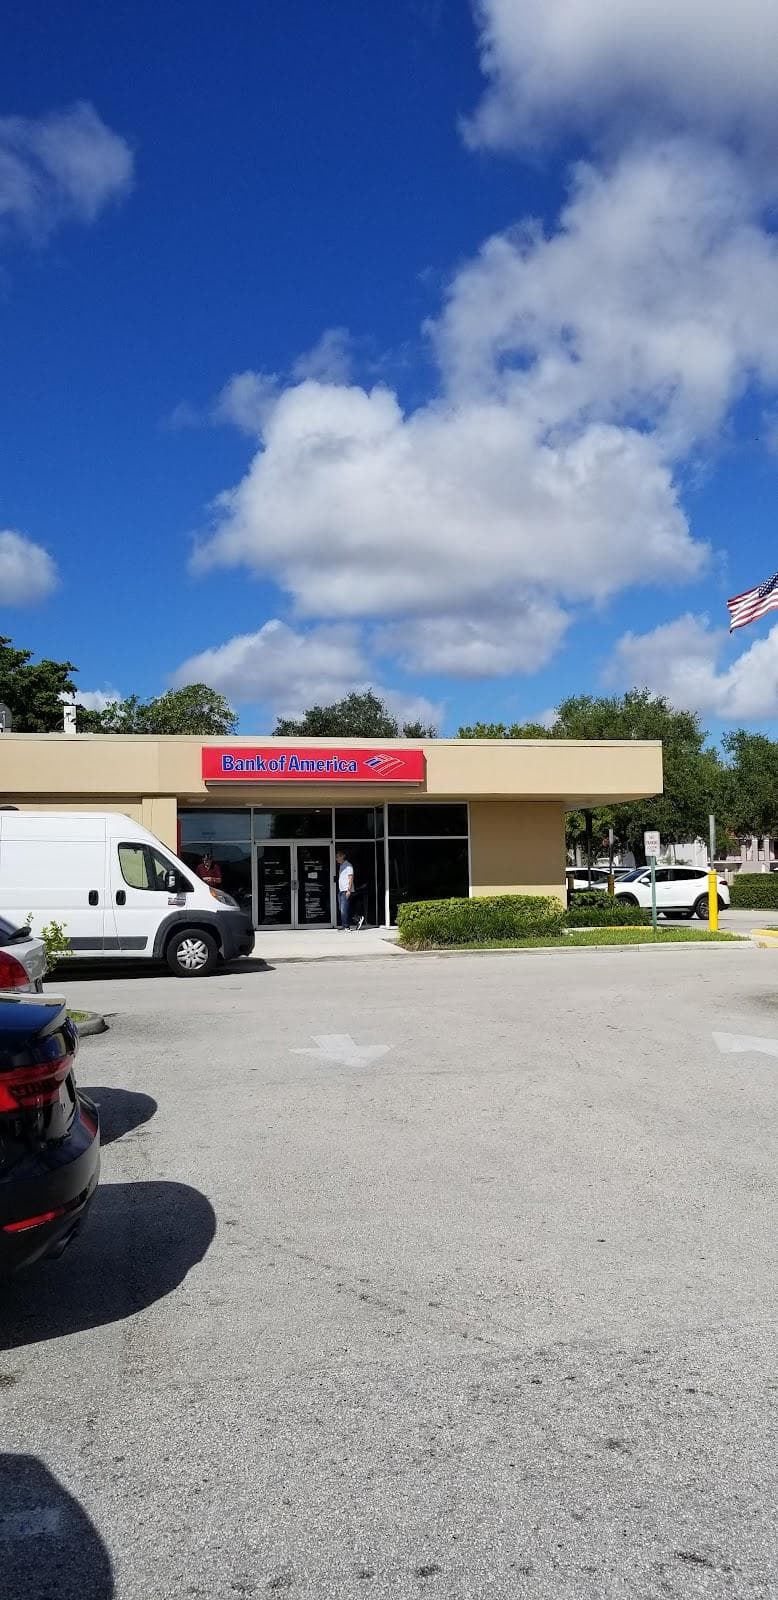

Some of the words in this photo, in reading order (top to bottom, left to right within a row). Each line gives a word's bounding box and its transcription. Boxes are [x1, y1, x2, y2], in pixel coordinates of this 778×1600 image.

[221, 754, 267, 772] Bank
[268, 755, 286, 772] of
[288, 755, 358, 773] America
